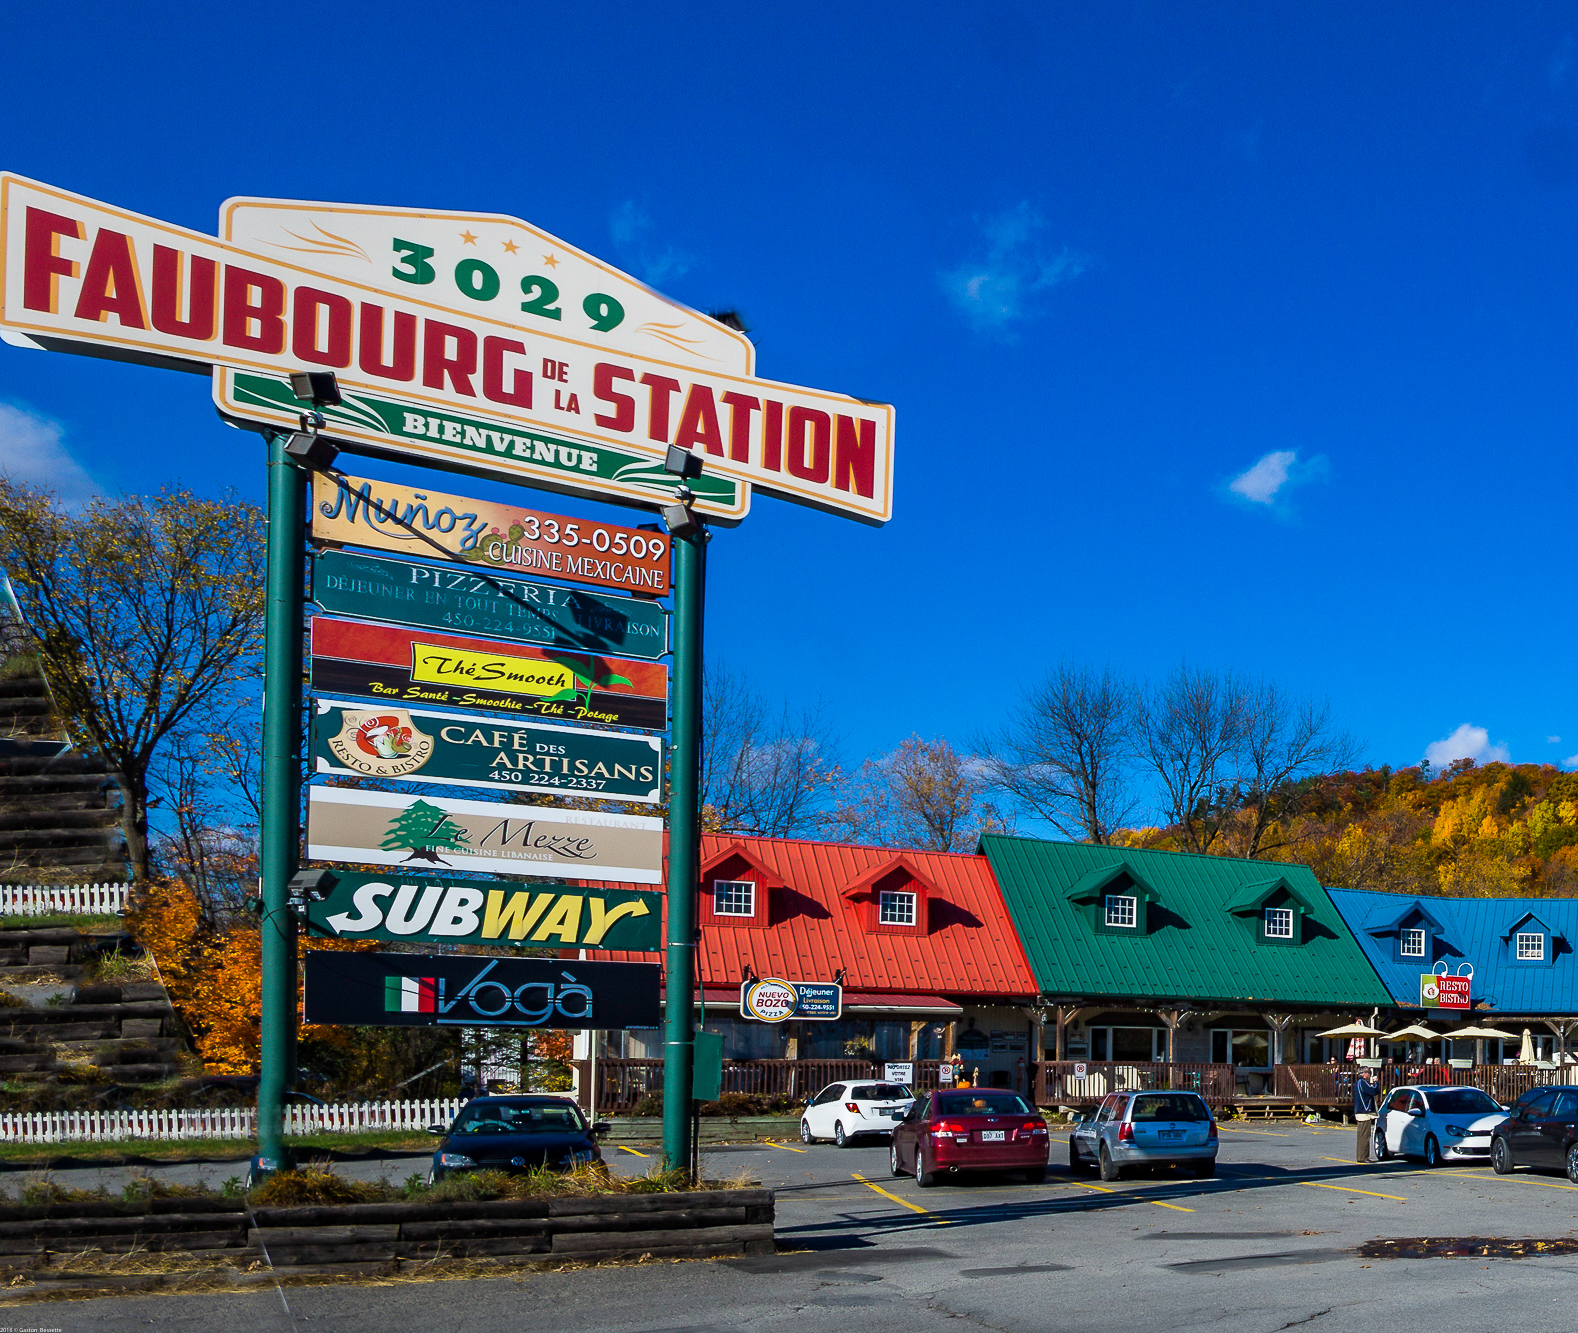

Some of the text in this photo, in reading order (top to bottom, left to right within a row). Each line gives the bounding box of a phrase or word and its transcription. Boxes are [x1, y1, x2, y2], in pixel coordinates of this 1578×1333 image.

[392, 237, 625, 333] 3029
[23, 205, 877, 500] FAUBOURG DE LA STATION
[402, 412, 598, 472] BIENVENUE
[319, 476, 489, 550] Muñoz
[523, 515, 666, 562] 335-0509
[488, 541, 664, 590] CUISINE MEXICAINE
[409, 567, 583, 610] PIZZERIA
[326, 574, 661, 638] DÉJEUNER EN TOUT TEMPS LIVRAISON
[442, 611, 557, 640] 450-224-9551
[368, 682, 399, 695] Bar
[402, 686, 449, 701] Santé
[440, 726, 566, 755] CAFÉ DES
[332, 739, 430, 775] RESTO & BISTRO
[489, 751, 654, 782] ARTISANS
[489, 770, 607, 790] 450 224-2337
[420, 814, 598, 860] Le Mezze
[565, 815, 649, 830] RESTAURANT
[425, 844, 554, 862] FINE CUISINE LIBANAISE
[325, 881, 651, 945] SUBWAY
[758, 991, 790, 999] NUEVO
[799, 986, 834, 998] Déjeuner
[1439, 980, 1469, 992] RESTO
[1439, 992, 1469, 1004] BISTRO
[756, 999, 790, 1008] BOZO
[760, 1009, 784, 1017] PIZZA
